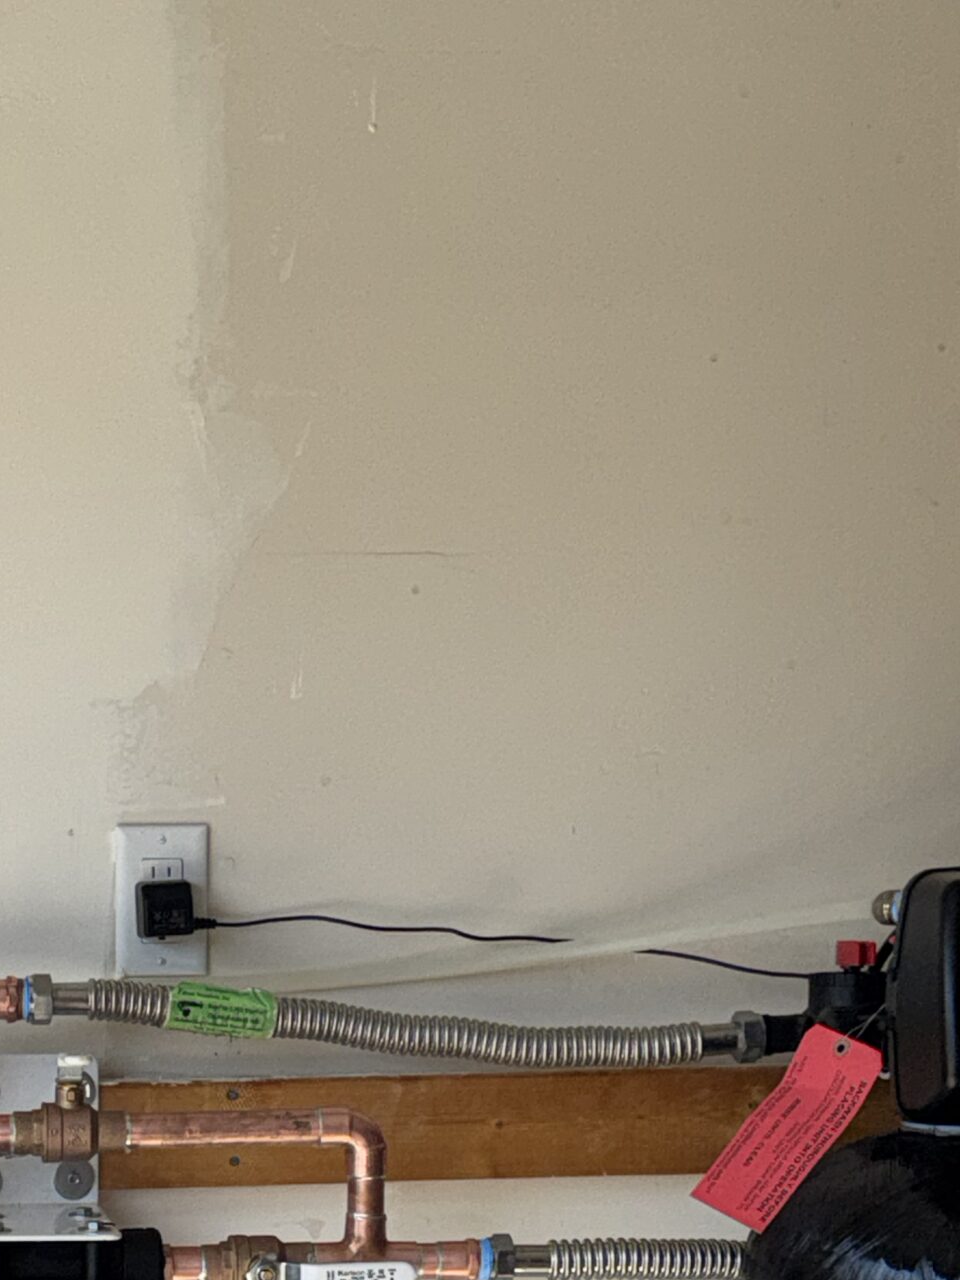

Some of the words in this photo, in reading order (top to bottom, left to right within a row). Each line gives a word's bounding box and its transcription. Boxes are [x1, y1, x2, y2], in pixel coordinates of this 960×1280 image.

[778, 1096, 802, 1120] RINSE
[824, 1084, 855, 1124] PLACING
[829, 1080, 867, 1132] BACKWASH
[809, 1122, 828, 1144] UNIT
[785, 1130, 833, 1188] THOROUGHLY
[792, 1141, 812, 1164] INTO
[755, 1162, 796, 1213] OPERATION
[758, 1187, 789, 1224] BEFORE
